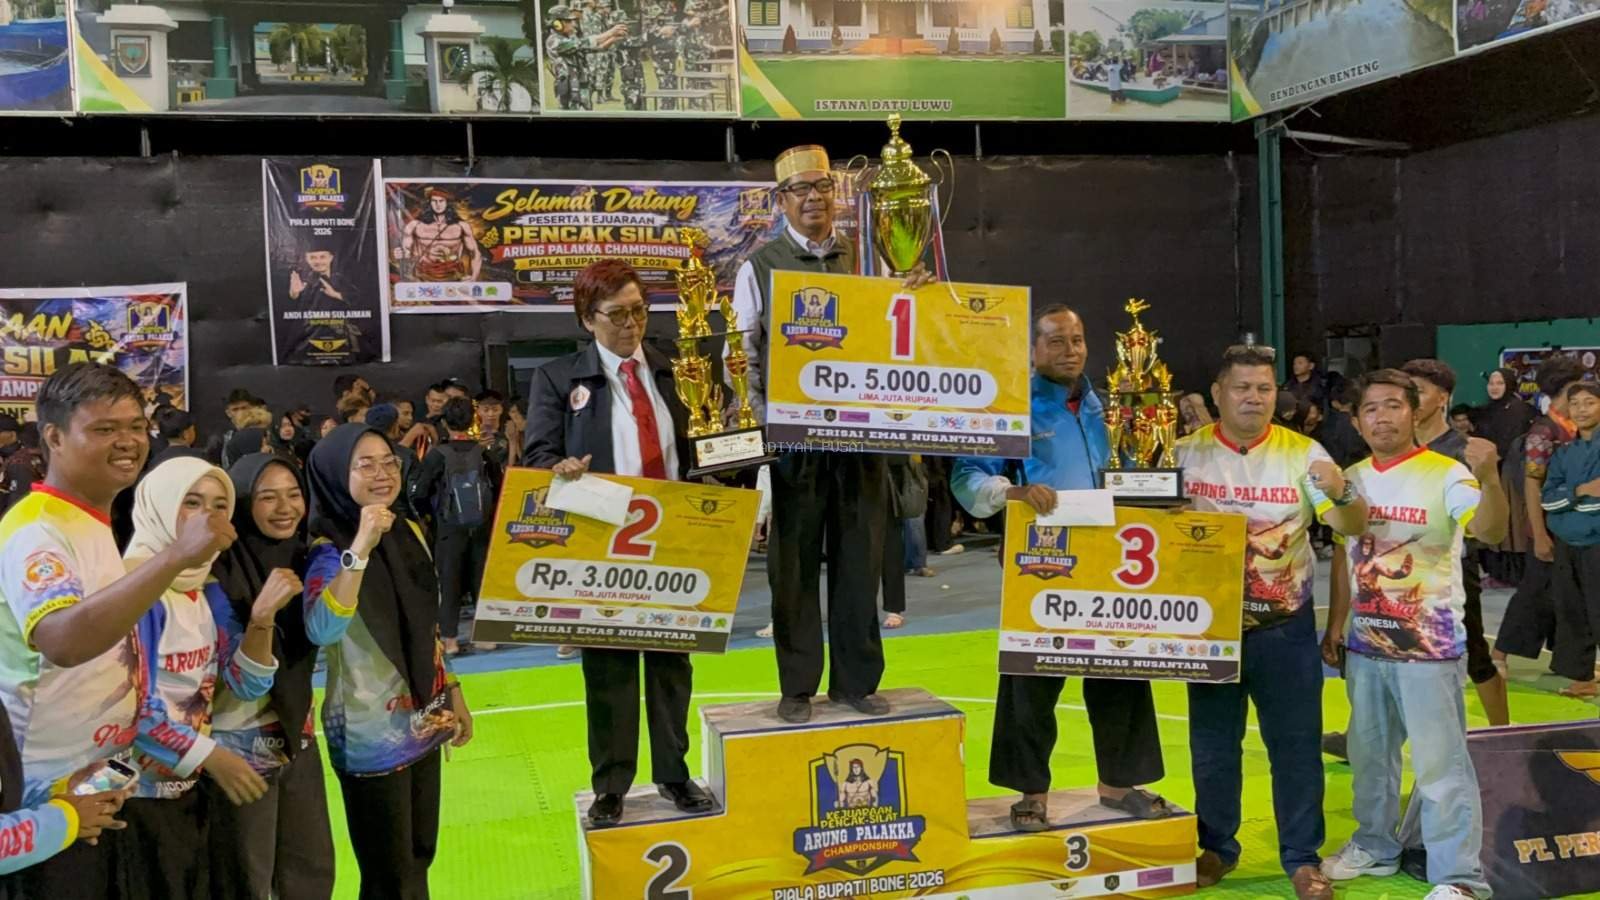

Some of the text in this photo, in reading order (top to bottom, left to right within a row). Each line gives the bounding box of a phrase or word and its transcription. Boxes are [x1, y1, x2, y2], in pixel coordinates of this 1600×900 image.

[1330, 60, 1380, 84] BENTENG
[815, 100, 952, 111] ISTANA DATU LUWU
[483, 187, 598, 221] Selamat
[602, 186, 698, 220] Datang
[528, 215, 655, 225] PESERTA KEJUARAAN
[503, 226, 612, 244] PENCAK
[503, 246, 545, 258] ARUNG
[547, 245, 601, 256] PALAKKA
[528, 258, 561, 267] PIALA
[642, 259, 669, 267] 2026
[283, 310, 371, 319] ANDI ASMAN SULAIMAN
[886, 294, 916, 361] 1
[814, 365, 982, 395] Rp. 5.000.000
[858, 393, 938, 404] LIMA JUTA RUPIAH
[807, 428, 996, 444] PERISAI EMAS NUSANTARA
[1233, 487, 1299, 504] PALAKKA
[1368, 506, 1427, 524] PALAKKA
[609, 495, 662, 560] 2
[1112, 523, 1159, 589] 3
[531, 562, 697, 594] Rp. 3.000.000
[574, 590, 651, 601] TIGA JUTA RUPIAH
[1045, 594, 1199, 622] Rp. 2.000.000
[515, 624, 697, 640] PERISAI EMAS NUSANTARA
[1086, 620, 1157, 631] DUA JUTA RUPIAH
[165, 645, 210, 673] ARUN
[1036, 655, 1208, 670] PERISAI EMAS NUSANTARA
[820, 812, 898, 829] PENCAK-SILAT
[826, 806, 893, 820] KEJUARAAN
[804, 822, 915, 851] ARUNG PALAKKA
[823, 841, 898, 858] CHAMPIONSHIP
[1064, 832, 1091, 870] 3
[1513, 837, 1555, 863] PT.
[645, 841, 691, 900] 2
[774, 871, 944, 900] PIALA BUPATI BONE 2026
